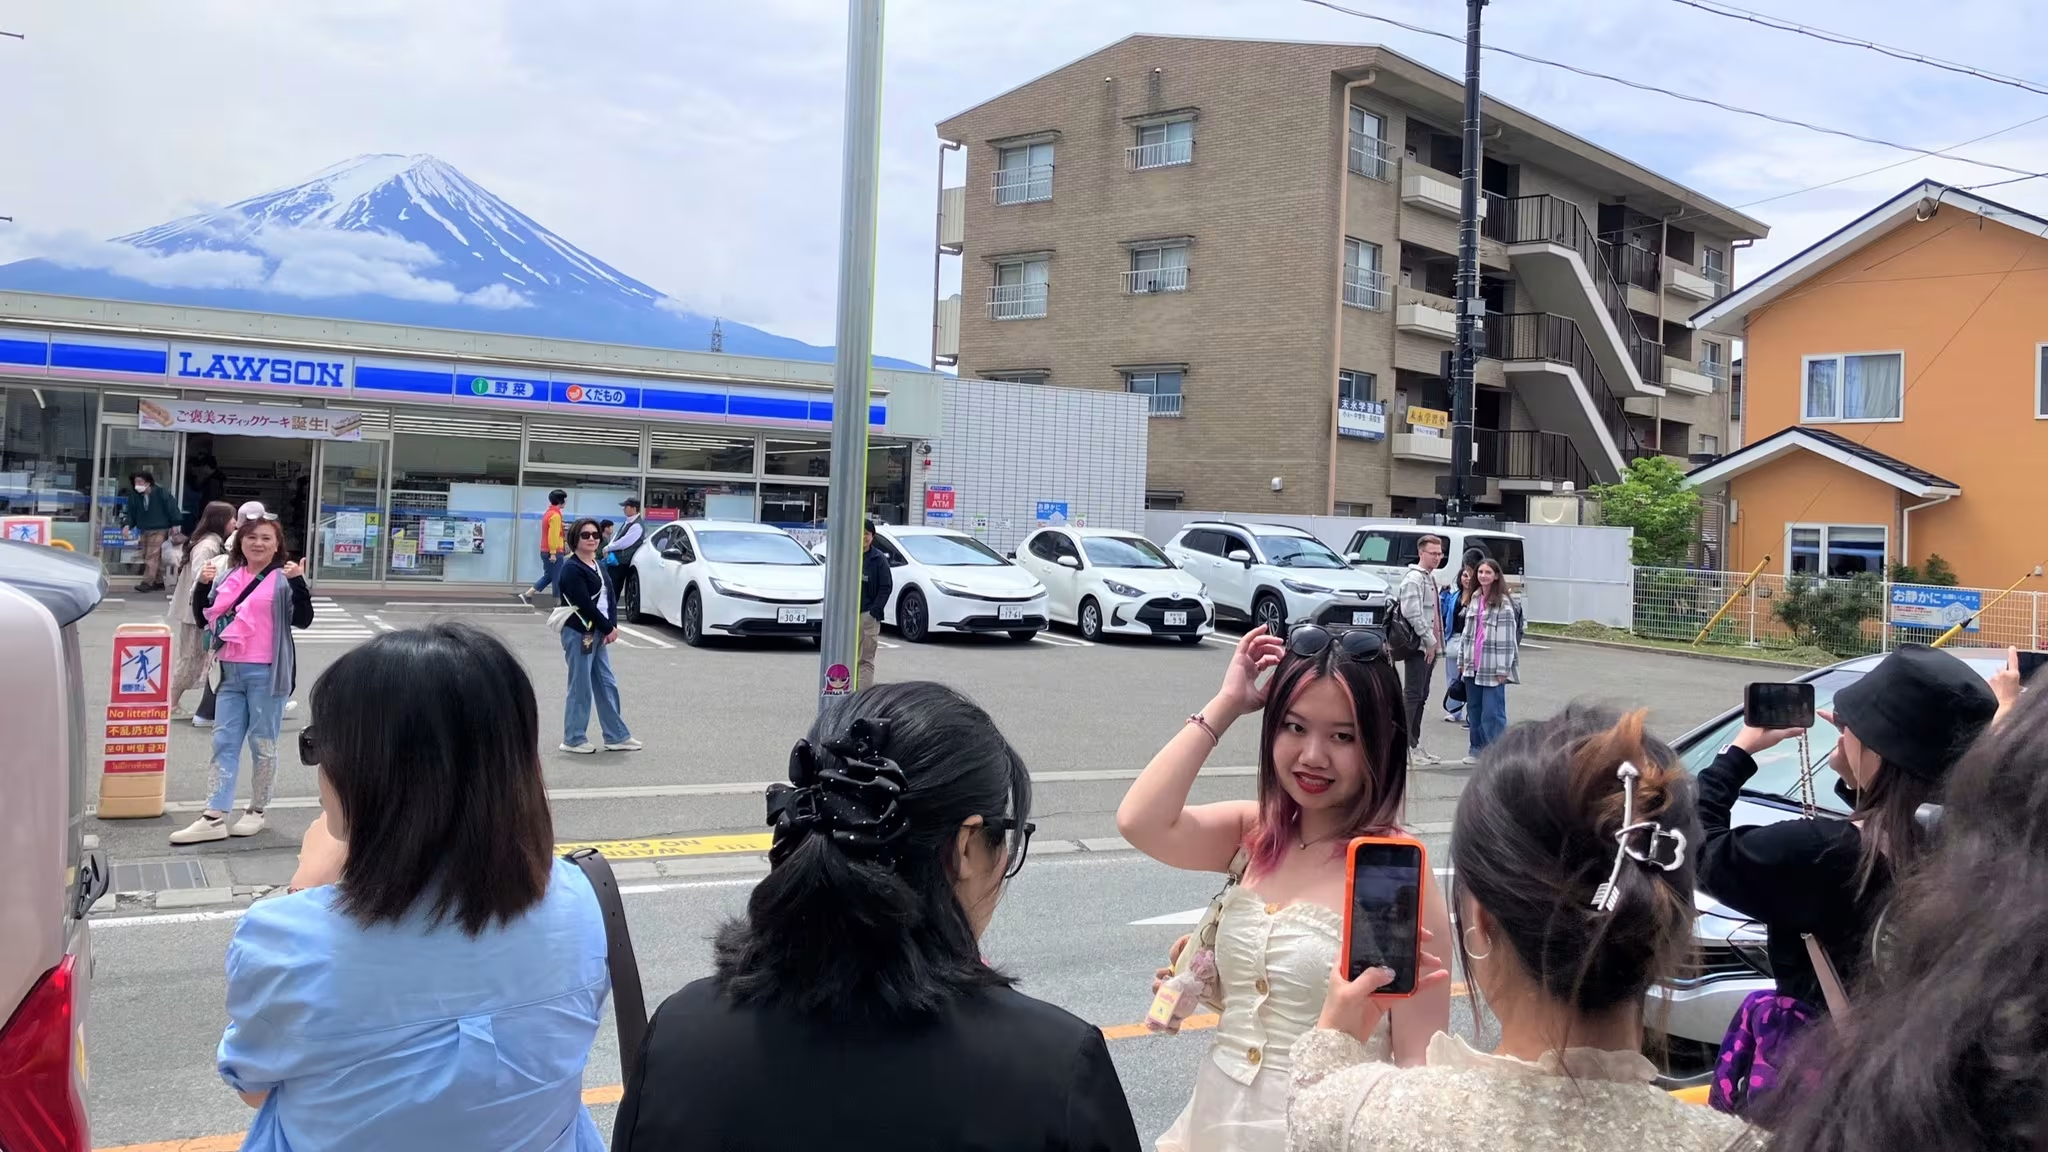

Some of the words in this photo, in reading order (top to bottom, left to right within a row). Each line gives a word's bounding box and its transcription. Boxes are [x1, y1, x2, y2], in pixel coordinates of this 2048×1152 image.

[178, 352, 344, 387] LAWSON
[494, 382, 526, 396] 野菜
[585, 388, 622, 402] くだもの
[931, 500, 950, 508] ATM
[1892, 589, 1941, 604] お静かに
[109, 709, 124, 718] No
[126, 708, 167, 719] littering
